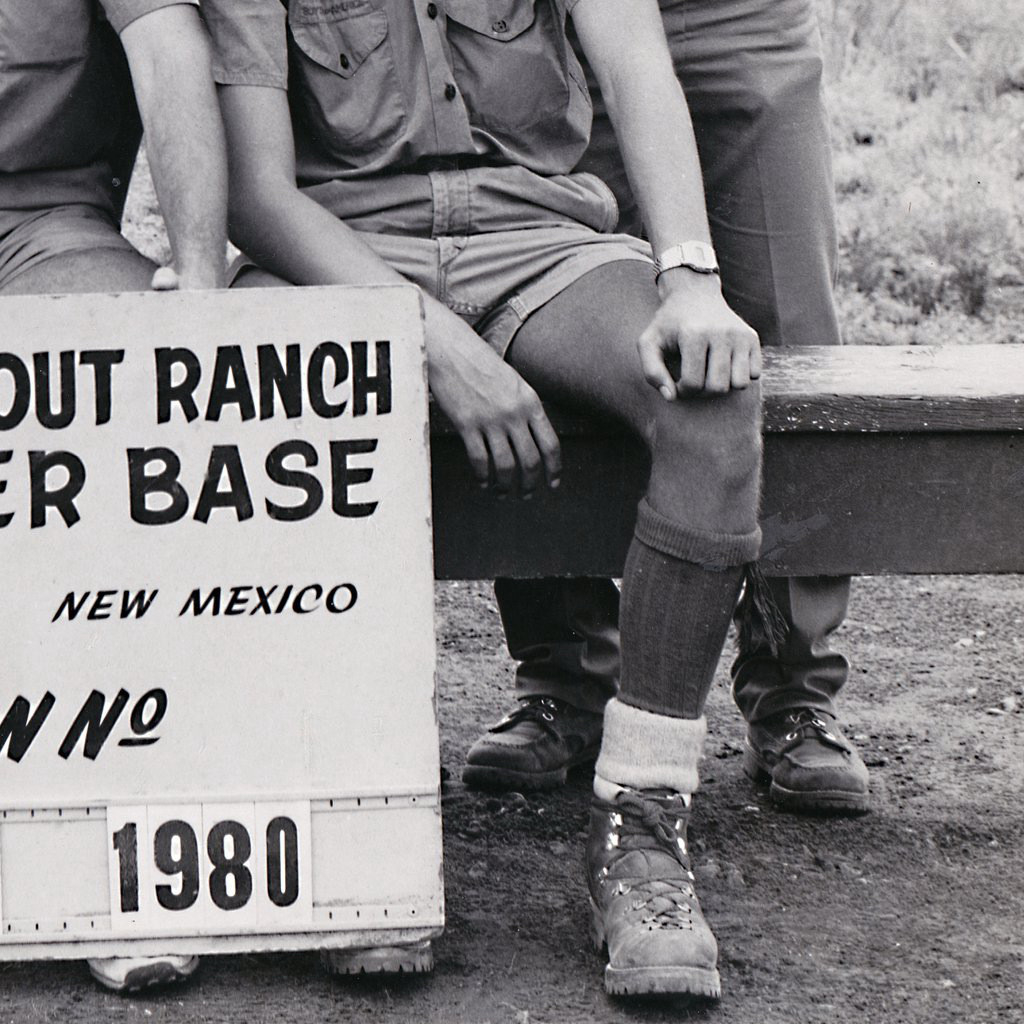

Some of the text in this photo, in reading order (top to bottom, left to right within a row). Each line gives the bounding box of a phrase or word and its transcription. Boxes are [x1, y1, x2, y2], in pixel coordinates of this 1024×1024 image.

[155, 341, 391, 424] RANCH
[127, 439, 378, 525] BASE
[52, 584, 357, 622] NEW MEXICO
[113, 817, 298, 912] 1980
